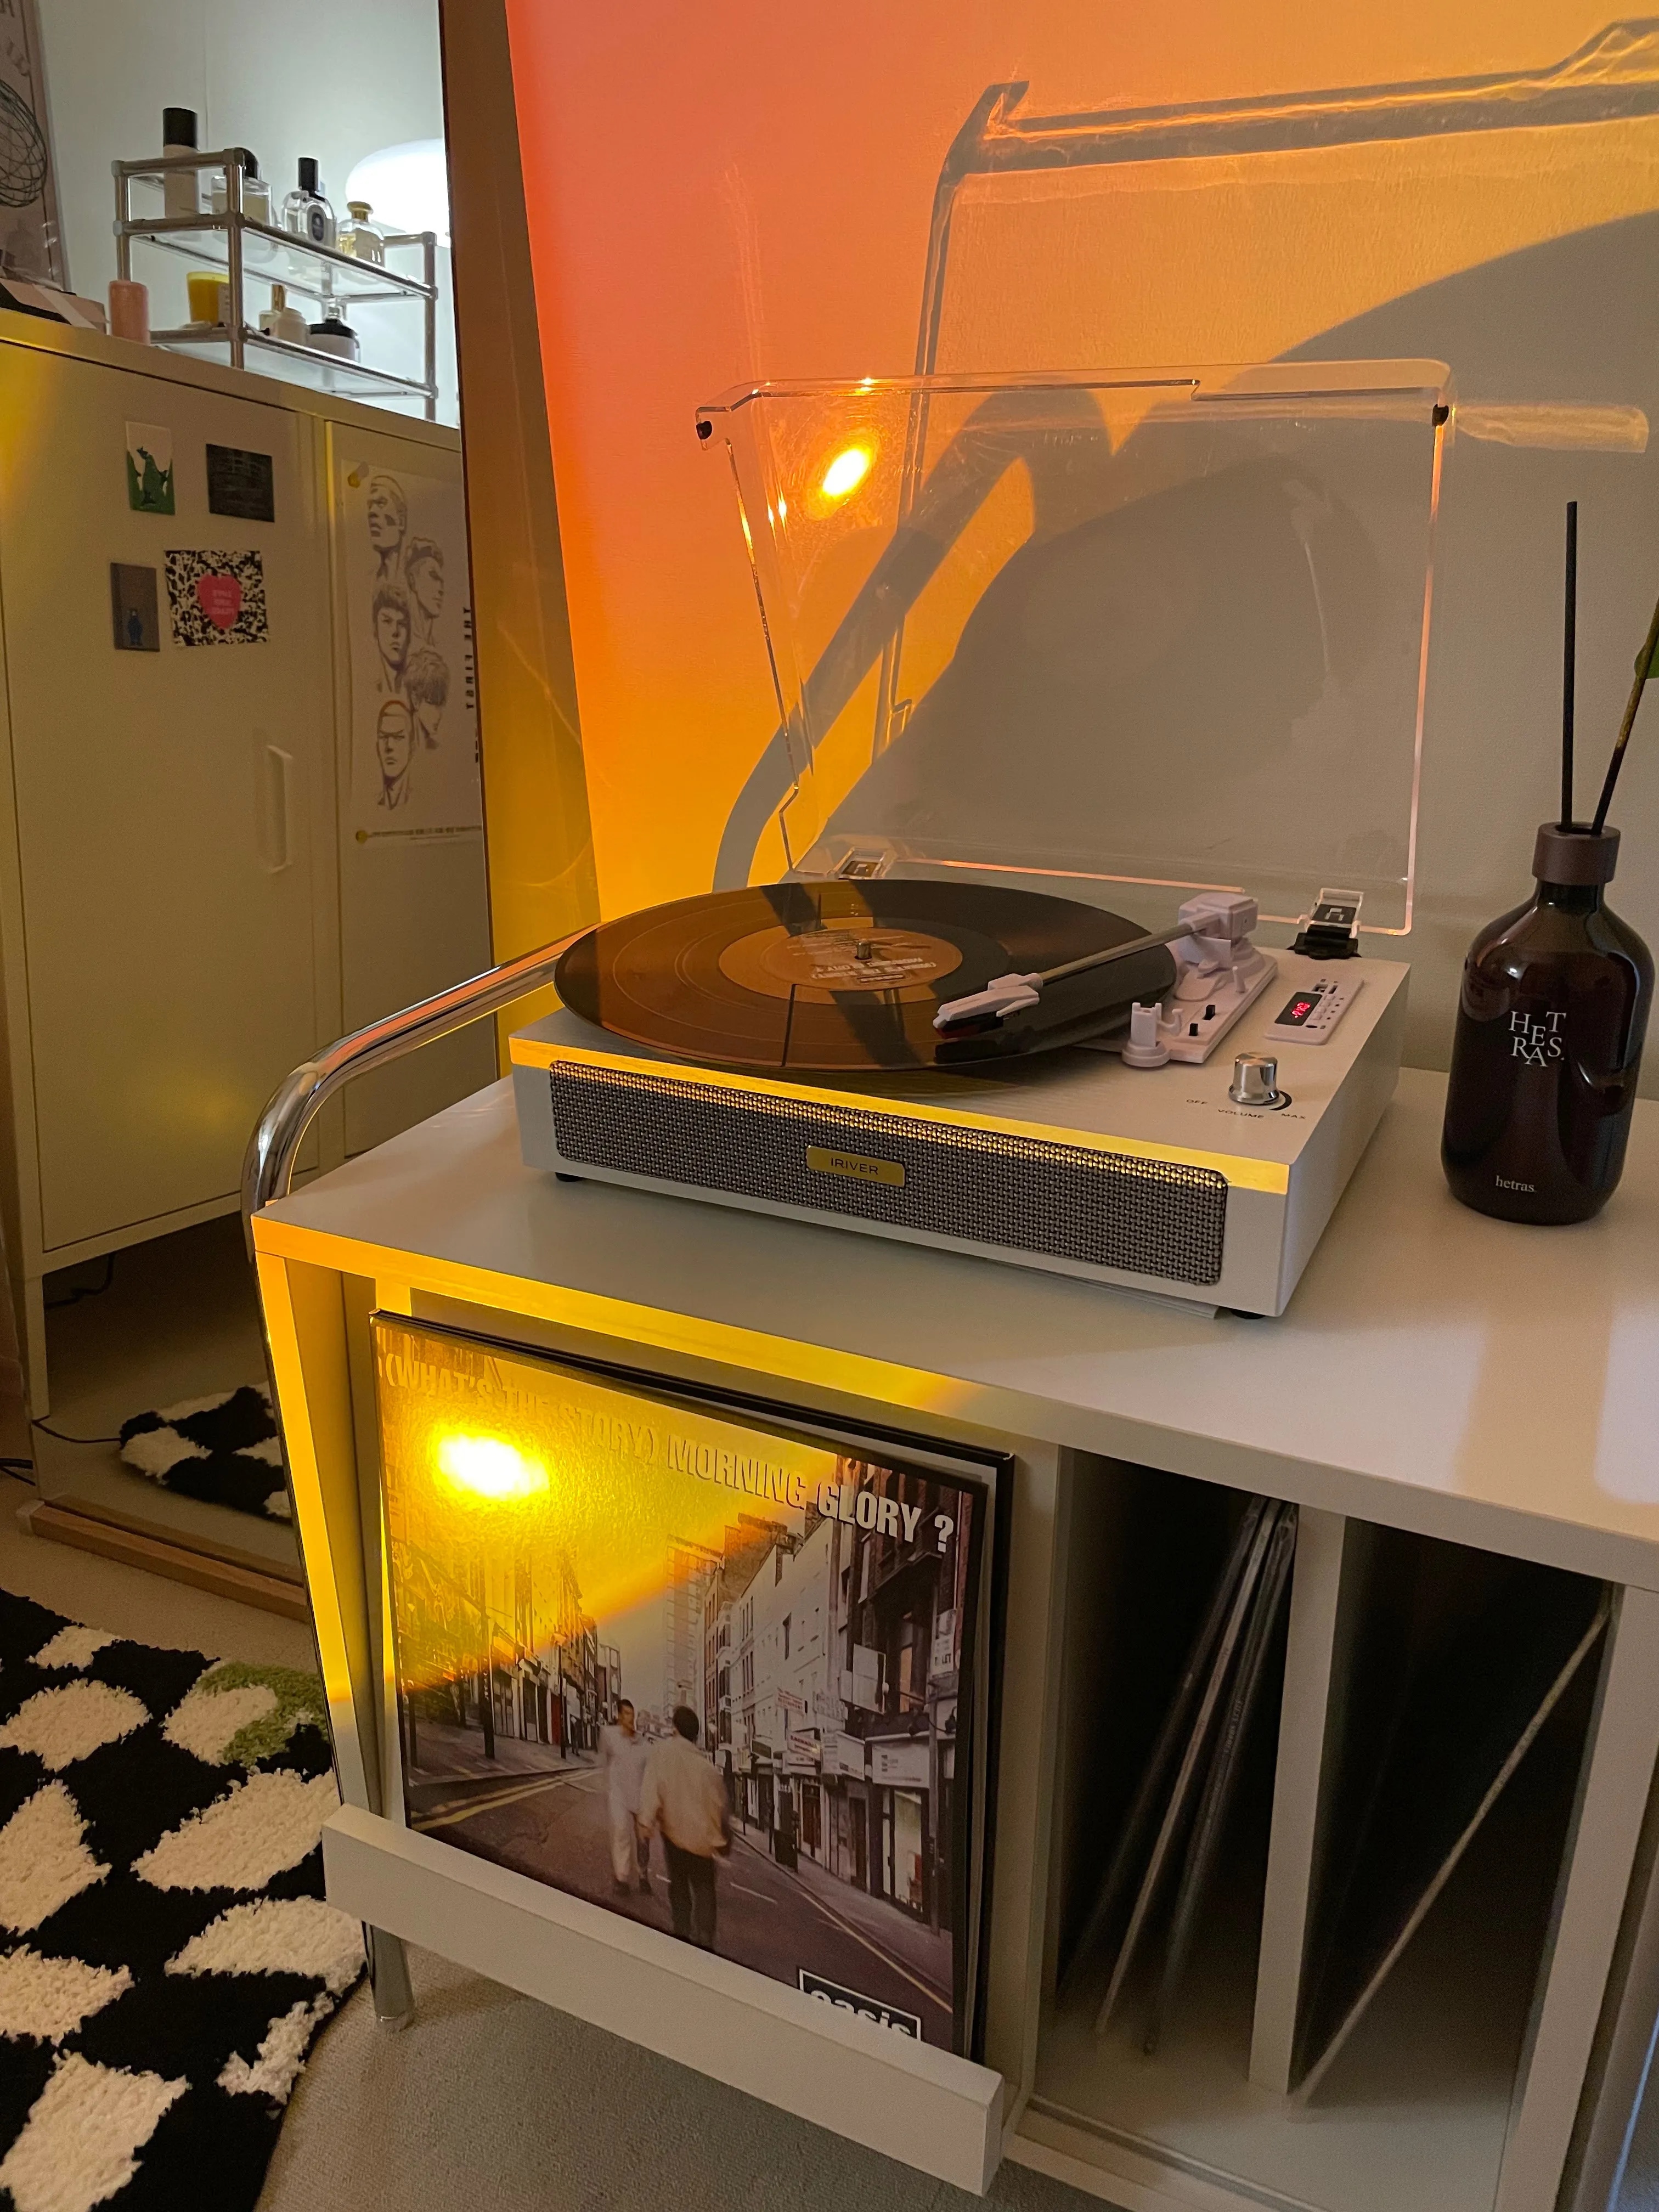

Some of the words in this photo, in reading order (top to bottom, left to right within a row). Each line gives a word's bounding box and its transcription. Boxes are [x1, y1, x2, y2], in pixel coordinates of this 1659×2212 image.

[1218, 1109, 1264, 1119] VOLUME
[831, 1157, 878, 1175] IRIVER
[667, 1434, 807, 1510] MORNING
[817, 1481, 922, 1544] GLORY
[934, 1514, 955, 1553] ?
